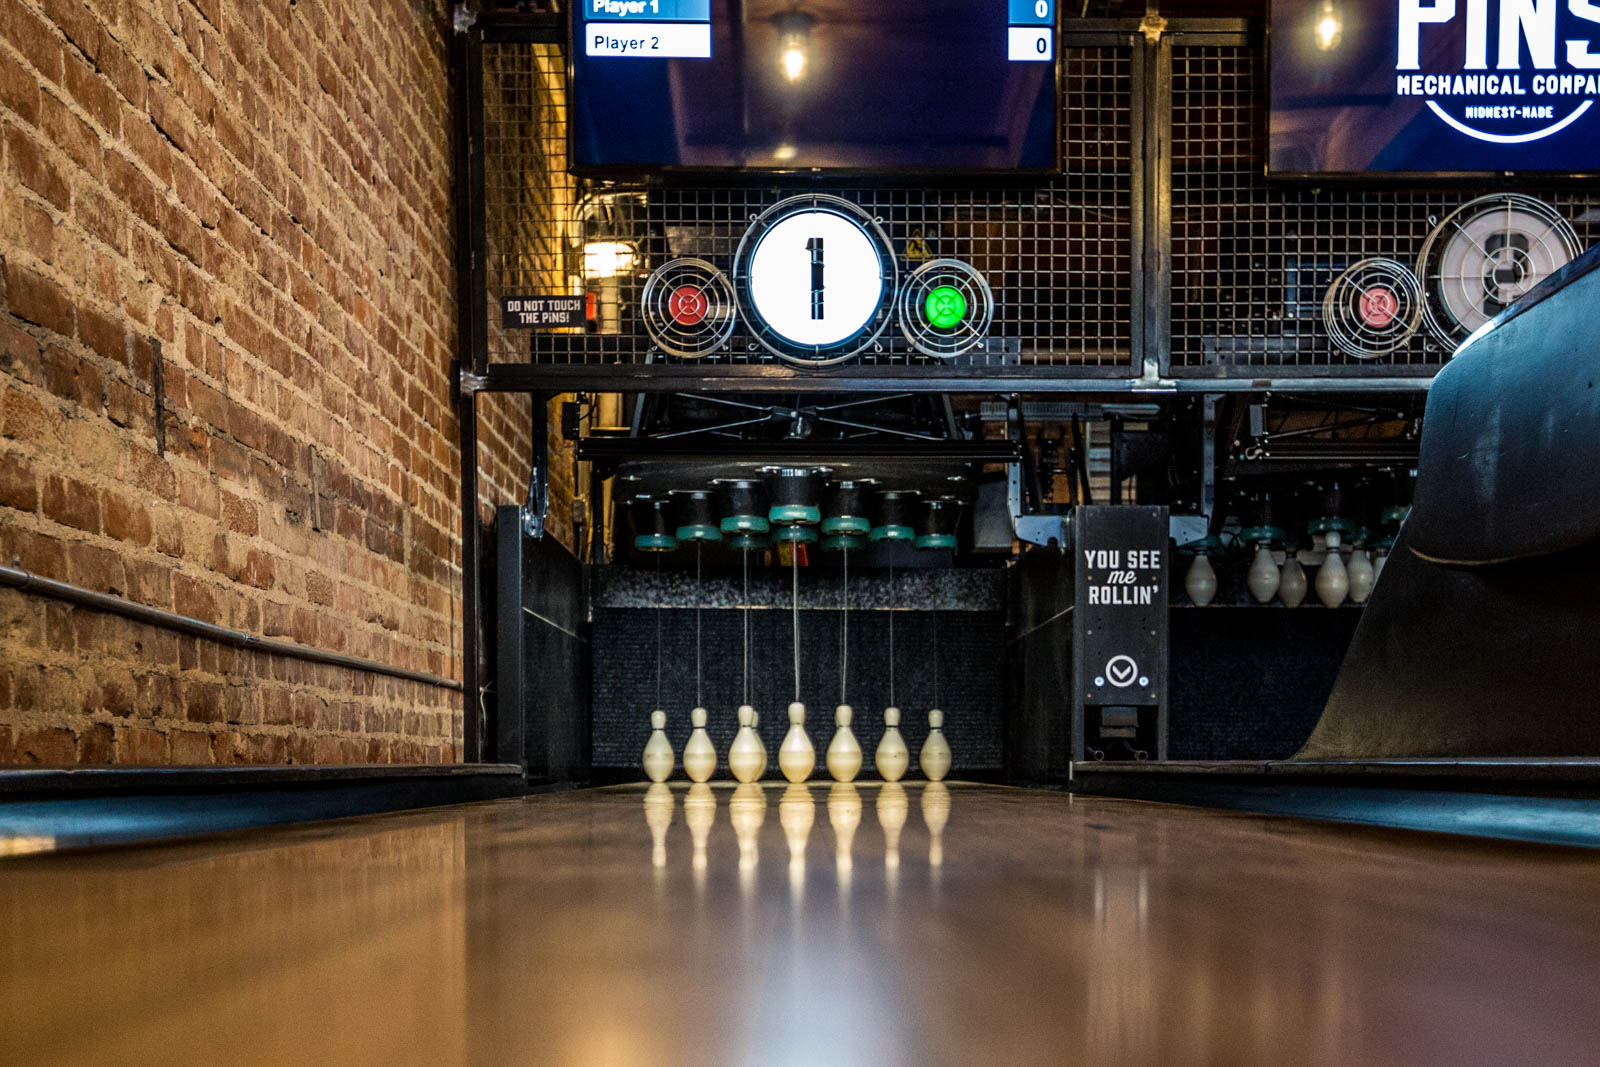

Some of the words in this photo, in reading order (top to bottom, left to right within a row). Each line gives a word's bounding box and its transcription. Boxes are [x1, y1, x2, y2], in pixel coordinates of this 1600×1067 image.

[593, 0, 647, 16] Player
[650, 0, 659, 13] 1
[1035, 0, 1048, 18] 0
[594, 35, 645, 52] Player
[651, 36, 659, 49] 2
[1036, 37, 1047, 54] 0
[1397, 75, 1526, 95] MECHANICAL
[1532, 75, 1600, 95] COMPA
[805, 237, 824, 320] 1
[507, 300, 521, 312] DO
[523, 300, 544, 311] NOT
[547, 299, 581, 311] TOUCH
[519, 313, 539, 324] THE
[1084, 550, 1119, 569] YOU
[1127, 550, 1161, 569] SEE
[1107, 570, 1137, 584] me
